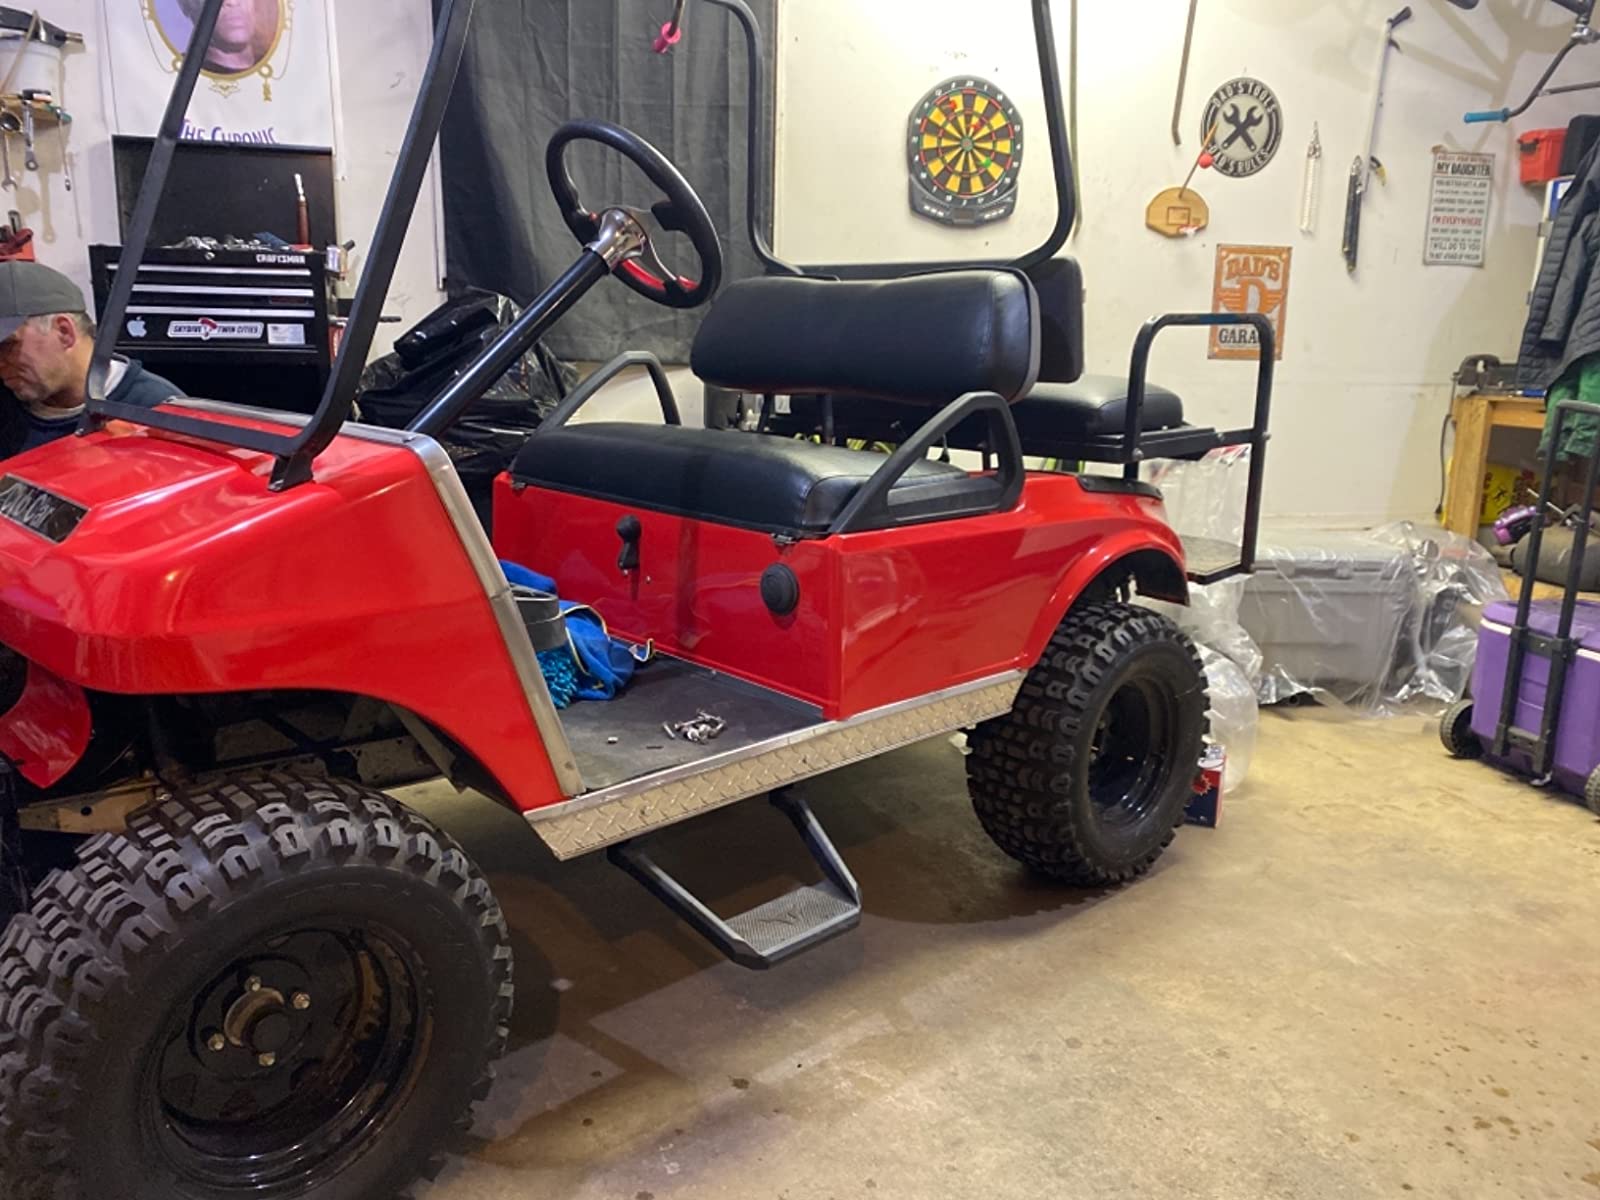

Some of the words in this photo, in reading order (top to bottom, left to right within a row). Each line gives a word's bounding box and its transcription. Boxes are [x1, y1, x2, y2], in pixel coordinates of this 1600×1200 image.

[1437, 162, 1450, 171] MY
[1451, 162, 1490, 177] DAUGHTER
[256, 253, 306, 264] CRAFTSMAN
[173, 325, 201, 333] SKYDIVE
[217, 325, 235, 333] TWIN
[237, 325, 259, 334] CITIES
[1218, 328, 1260, 344] GARA
